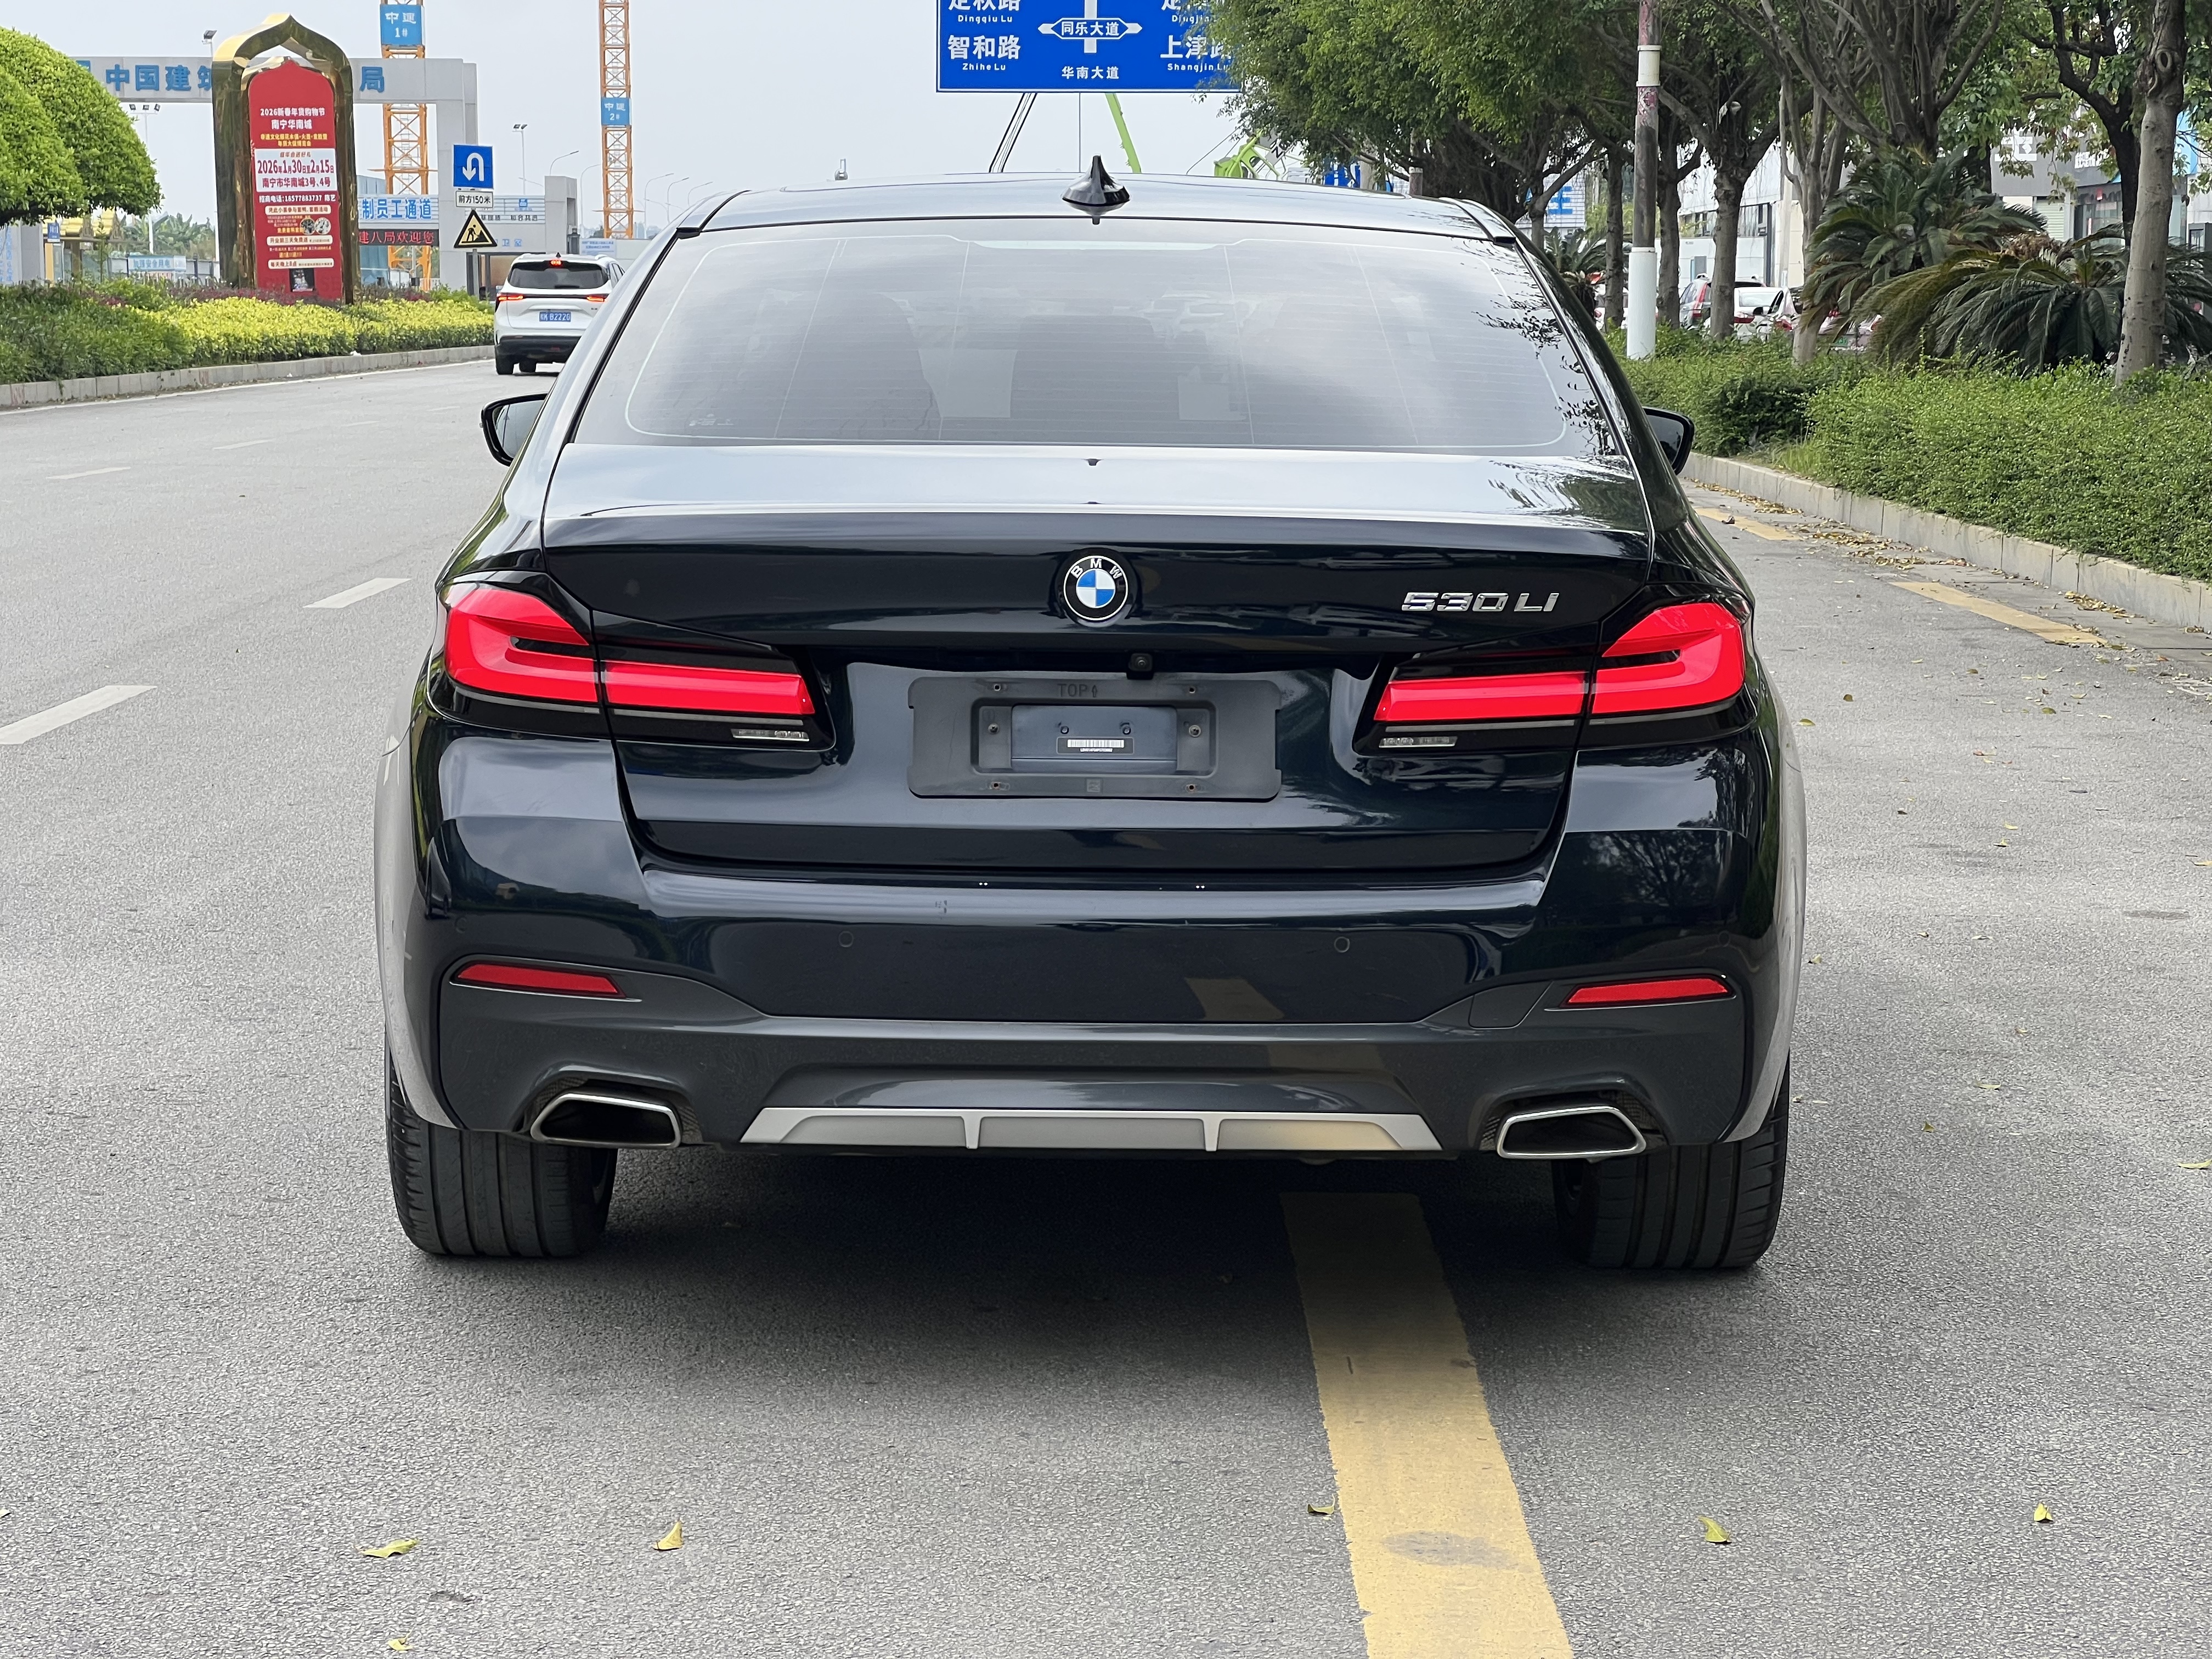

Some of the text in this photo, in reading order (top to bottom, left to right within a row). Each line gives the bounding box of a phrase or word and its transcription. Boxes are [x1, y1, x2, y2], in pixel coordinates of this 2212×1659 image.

[958, 15, 997, 24] Dingqiu
[395, 27, 408, 38] 1#
[1061, 21, 1120, 36] 同乐大道
[948, 35, 1021, 59] 智和路
[1062, 66, 1119, 80] 华南大道
[1167, 63, 1214, 72] Shangjin
[271, 119, 313, 129] 南宁华南城
[459, 195, 491, 205] 前方150米
[362, 198, 432, 219] 制员工通道
[1070, 558, 1122, 579] BMW
[1401, 592, 1509, 612] 530
[1057, 684, 1087, 697] TOP
